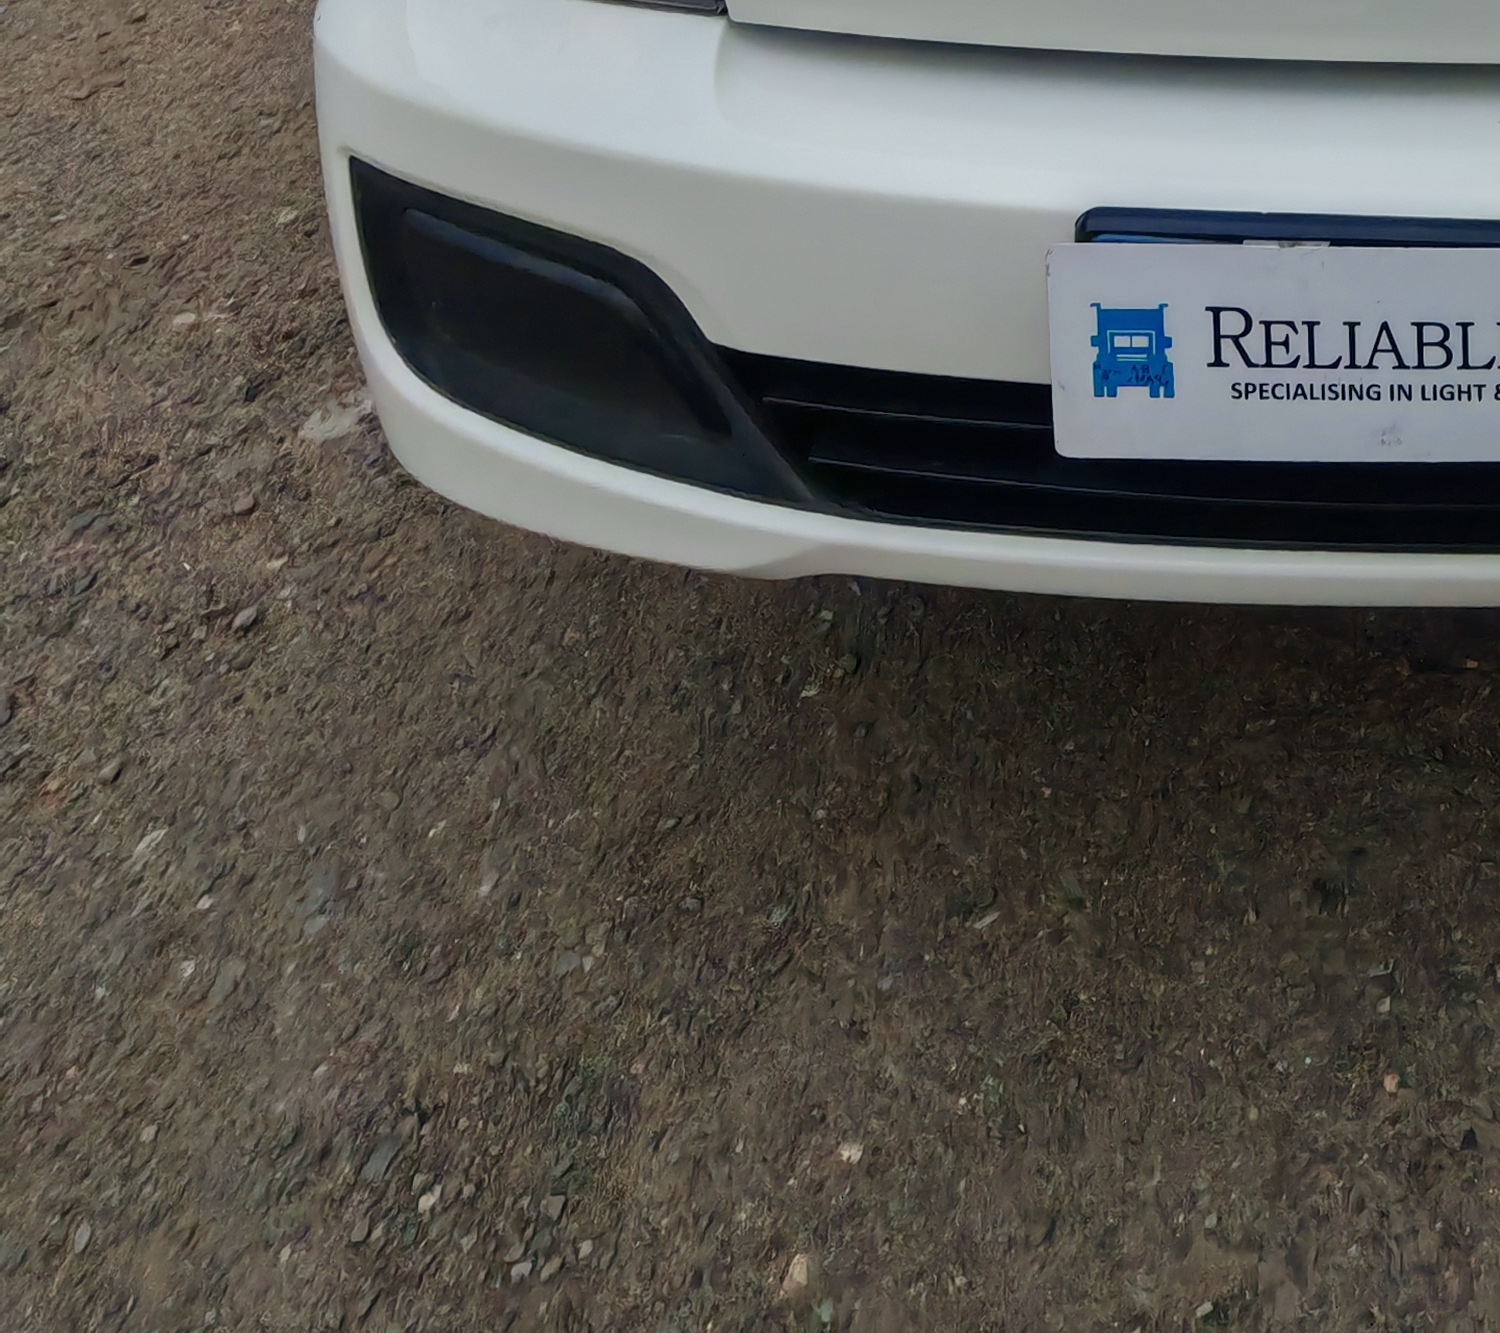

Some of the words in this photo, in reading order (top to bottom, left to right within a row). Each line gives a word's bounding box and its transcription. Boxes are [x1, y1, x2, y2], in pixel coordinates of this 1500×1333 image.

[1230, 382, 1382, 402] SPECIALISING
[1388, 382, 1414, 402] IN
[1419, 383, 1487, 402] LIGHT
